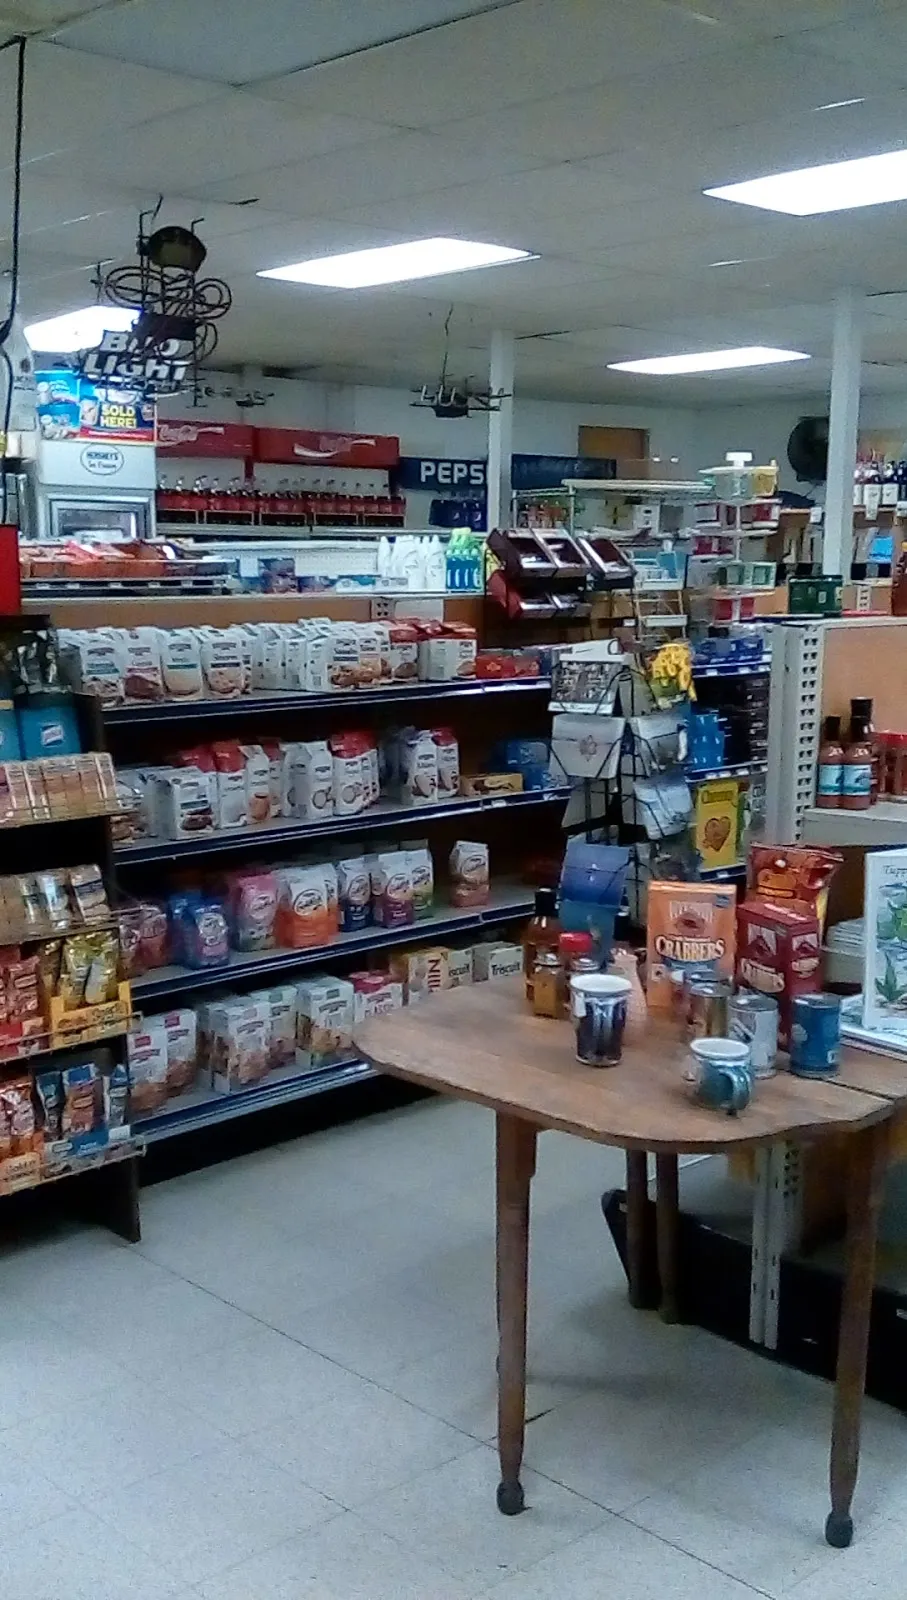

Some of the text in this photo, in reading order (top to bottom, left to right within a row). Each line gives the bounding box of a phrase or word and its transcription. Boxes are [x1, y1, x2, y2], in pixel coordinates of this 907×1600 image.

[84, 353, 188, 380] LIGHT
[101, 404, 136, 417] SOLD
[101, 416, 137, 428] HERE!
[420, 461, 487, 485] PEPS
[655, 935, 725, 962] CRABBERS
[491, 962, 521, 976] Triscuit
